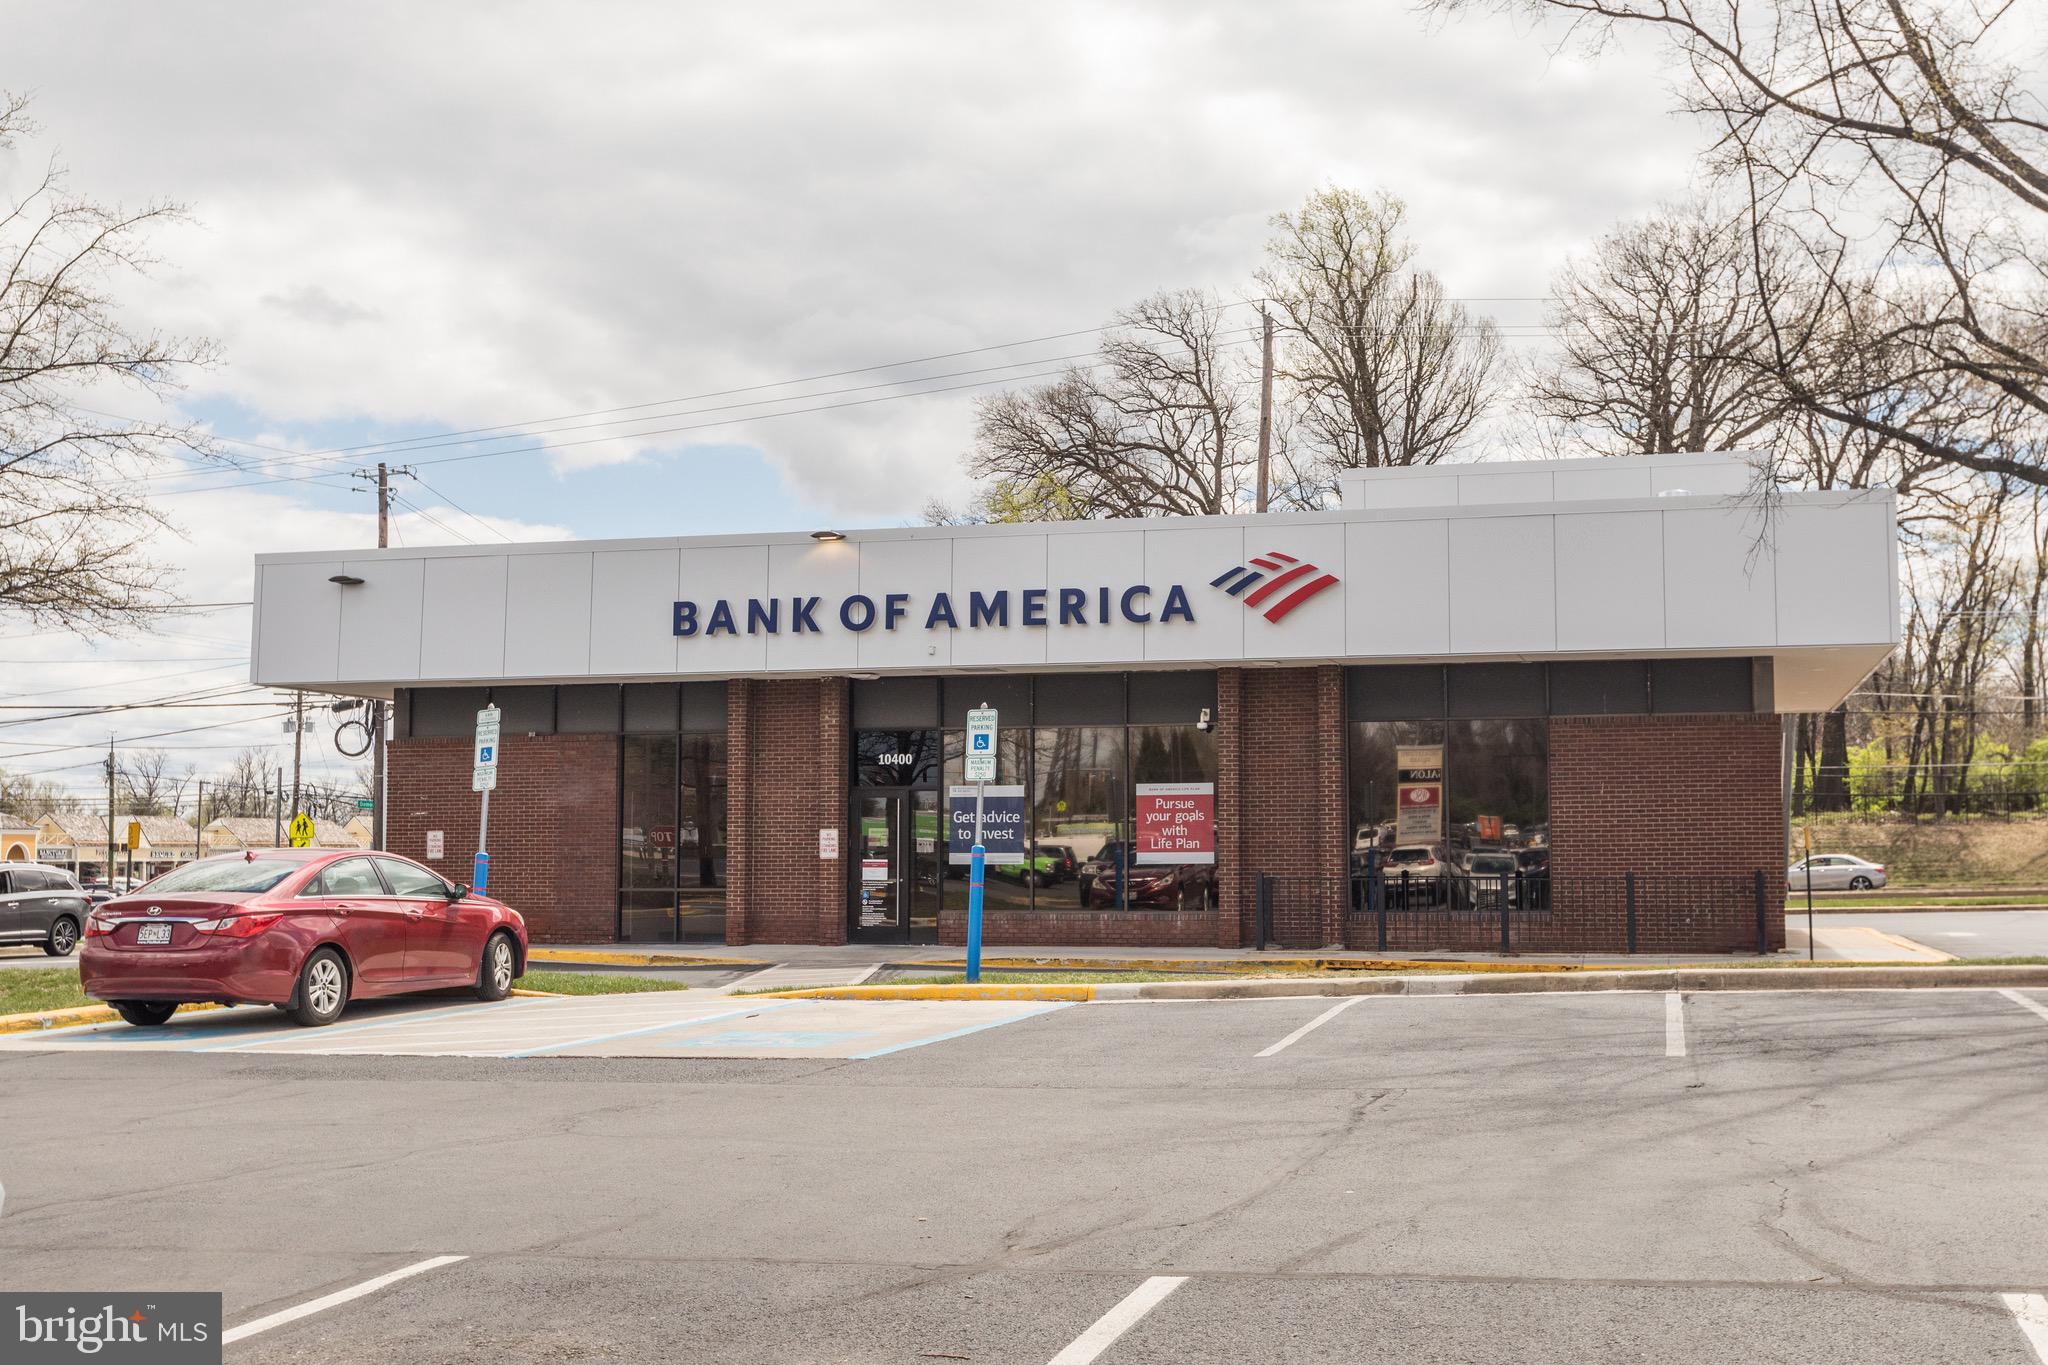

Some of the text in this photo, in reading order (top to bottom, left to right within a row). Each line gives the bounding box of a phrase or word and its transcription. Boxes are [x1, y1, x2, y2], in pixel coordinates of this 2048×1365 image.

[673, 584, 1195, 636] BANK OF AMERICA
[878, 753, 912, 765] 10400
[1155, 798, 1195, 809] Pursue
[953, 810, 1020, 823] Get advice
[1146, 810, 1205, 824] your goals
[958, 828, 1014, 840] to nvest
[1162, 825, 1188, 836] with
[1151, 837, 1200, 848] Life Plan
